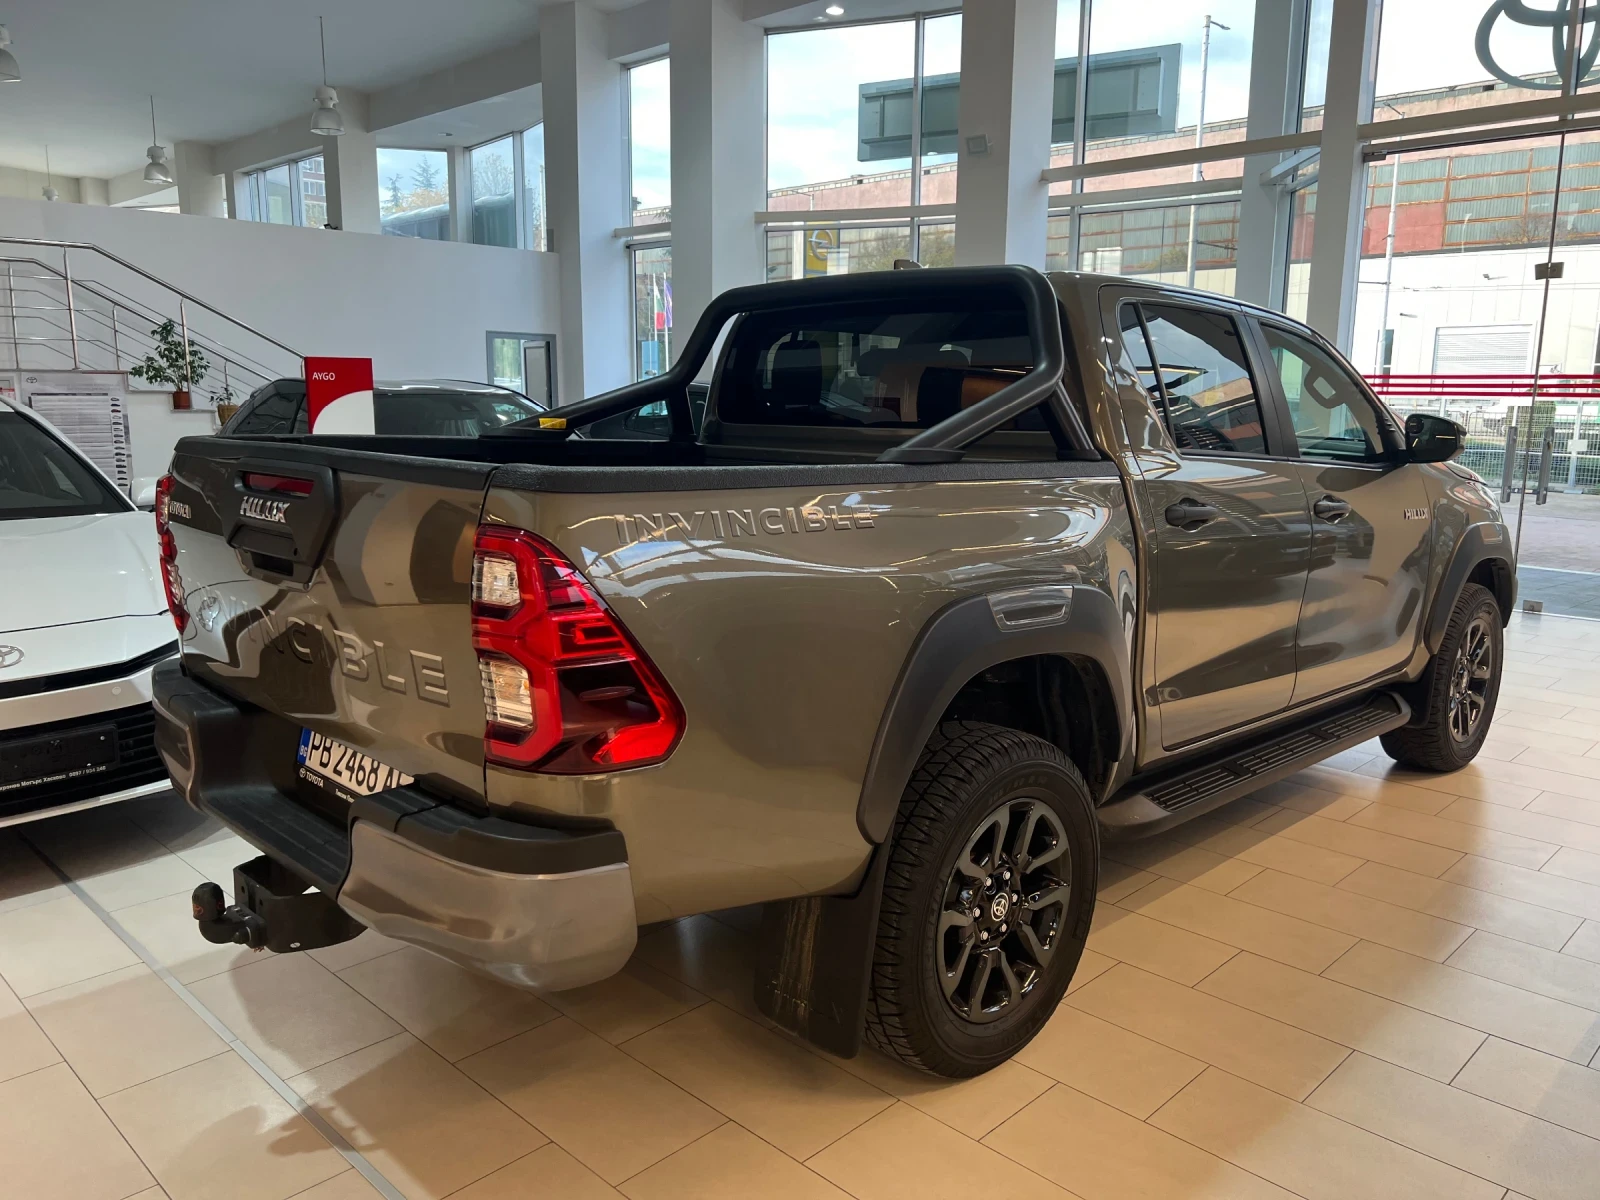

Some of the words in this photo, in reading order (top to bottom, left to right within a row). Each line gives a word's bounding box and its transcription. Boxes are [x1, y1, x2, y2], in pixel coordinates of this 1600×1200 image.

[312, 371, 336, 381] AYGO
[240, 495, 290, 523] HILUX
[1404, 507, 1428, 520] HILUX
[614, 503, 875, 546] INVINCIBLE
[299, 744, 308, 757] BG
[333, 743, 381, 793] 2468
[306, 772, 324, 789] TOYOTA
